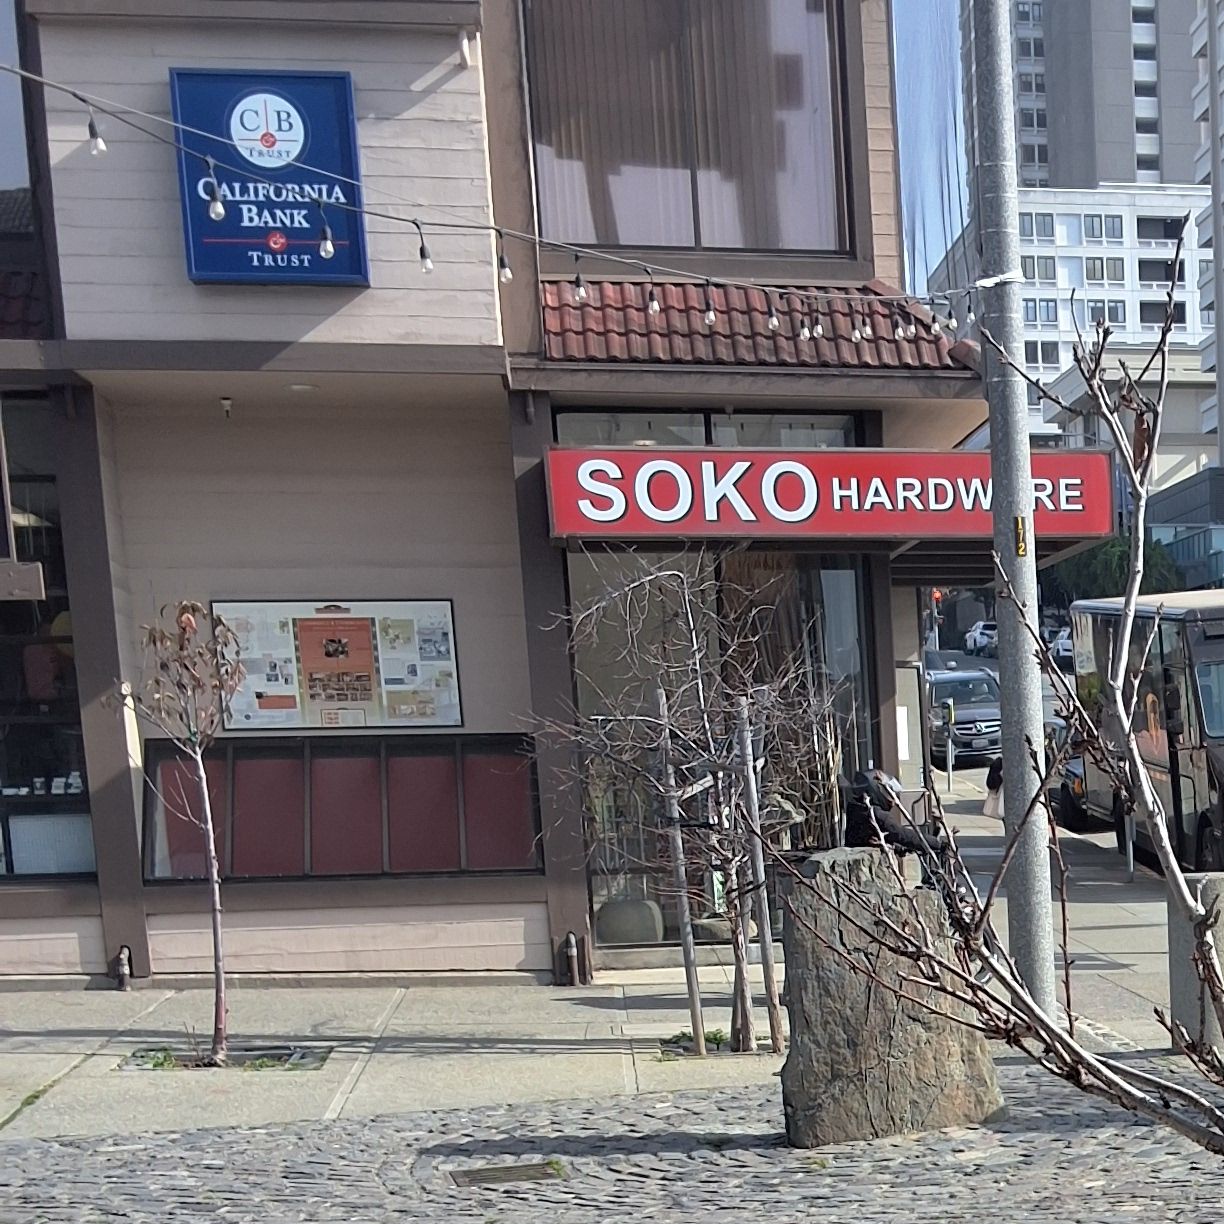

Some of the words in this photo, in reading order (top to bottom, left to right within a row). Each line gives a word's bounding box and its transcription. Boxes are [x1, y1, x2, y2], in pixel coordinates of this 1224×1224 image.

[248, 147, 292, 159] TRUST
[197, 177, 347, 203] CALIFORNIA
[239, 204, 311, 229] BANK
[248, 251, 312, 267] TRUST
[576, 460, 819, 523] SOKO
[832, 477, 1085, 512] HARDWRE
